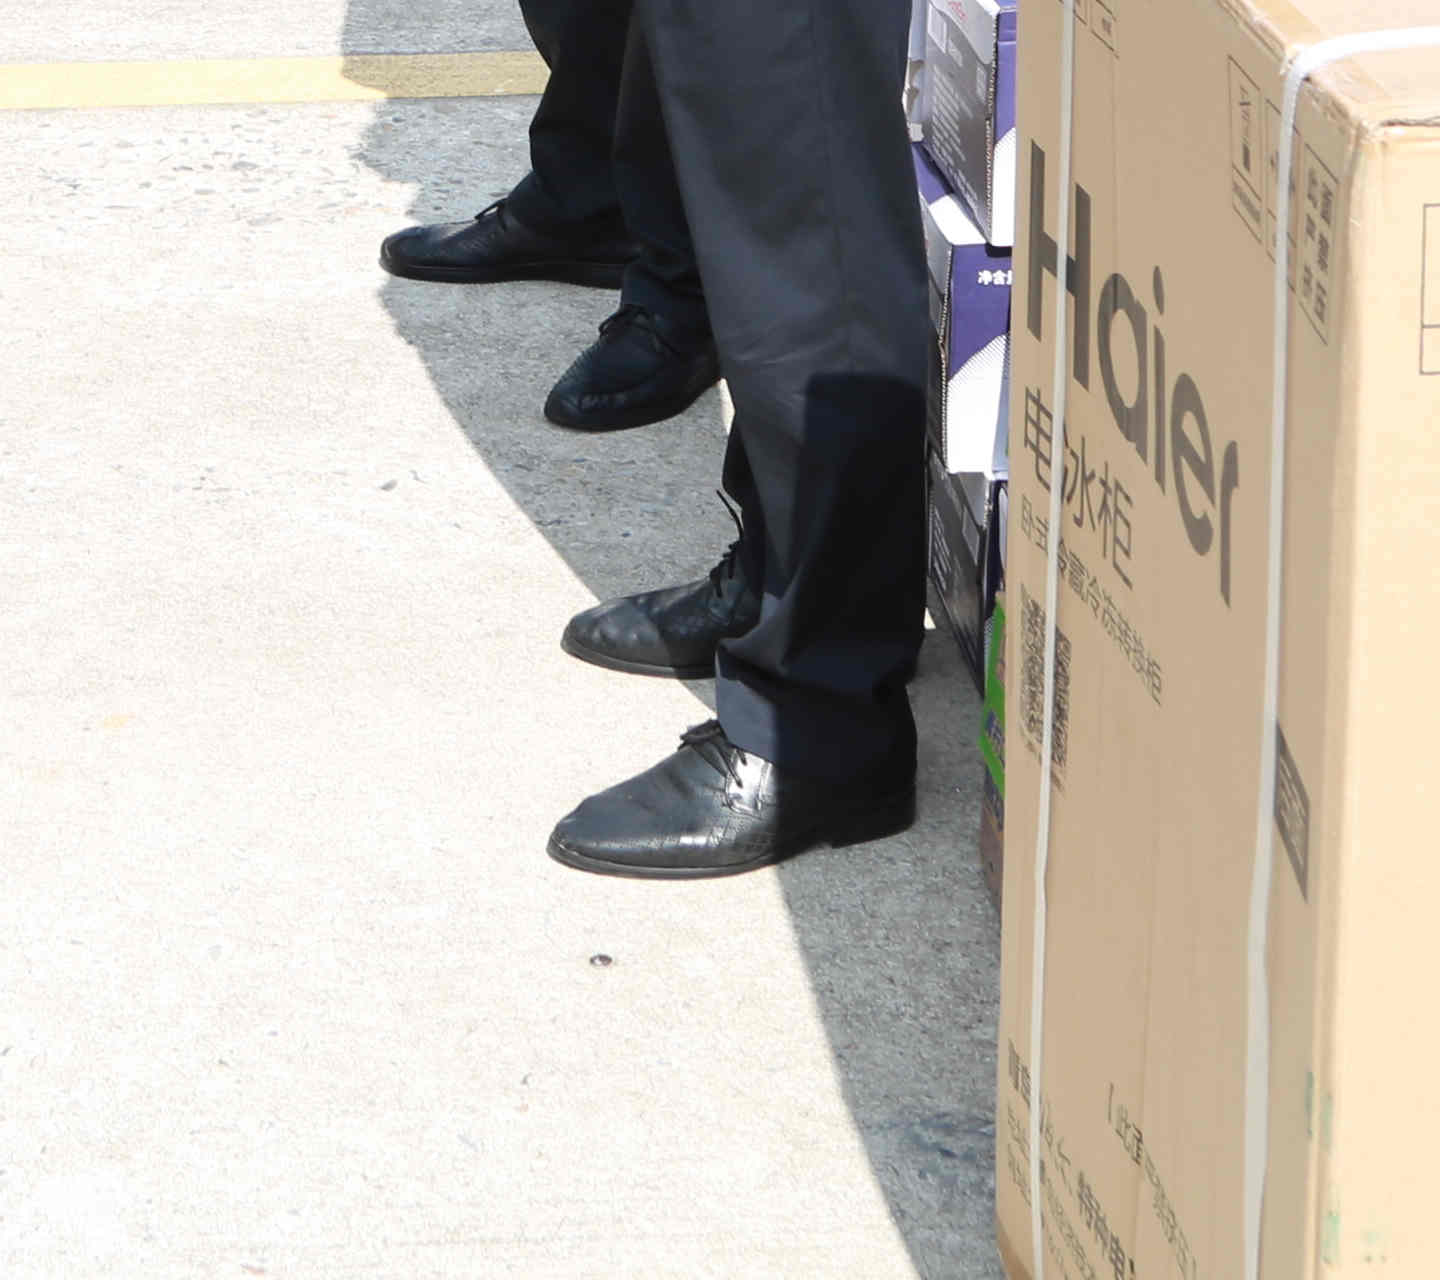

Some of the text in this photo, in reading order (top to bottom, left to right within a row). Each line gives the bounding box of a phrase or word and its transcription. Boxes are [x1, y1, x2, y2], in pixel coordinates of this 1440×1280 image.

[1023, 386, 1134, 591] 电冰柜
[1027, 140, 1239, 608] Haier
